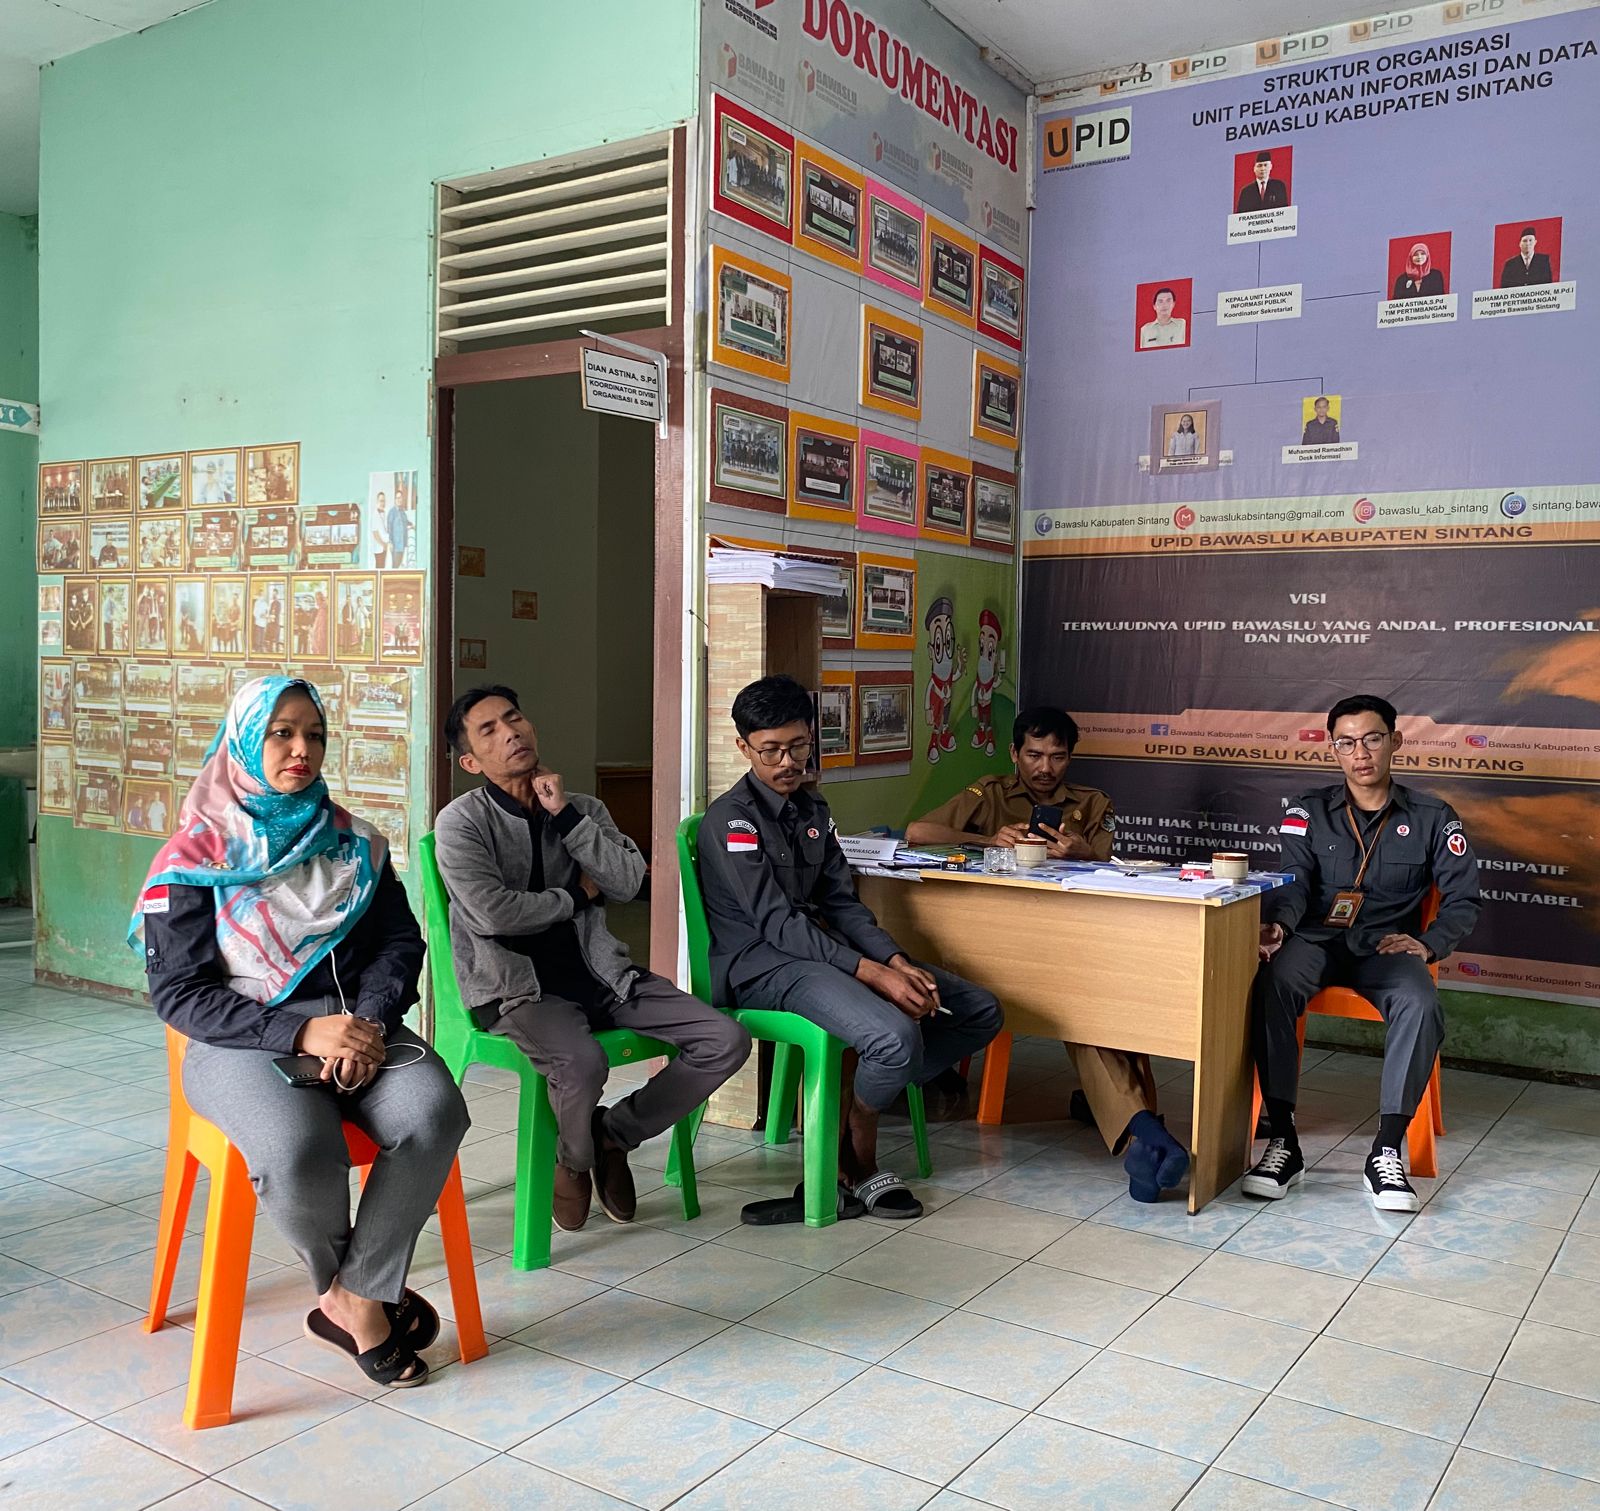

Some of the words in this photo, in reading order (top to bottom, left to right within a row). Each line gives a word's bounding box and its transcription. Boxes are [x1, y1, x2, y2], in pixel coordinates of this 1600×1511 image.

[1352, 14, 1414, 37] UPID
[1259, 34, 1329, 60] UPID
[1173, 55, 1227, 76] UPID
[1263, 60, 1370, 93] STRUKTUR
[1376, 32, 1511, 73] ORGANISASI
[738, 53, 785, 92] BAWASLU
[803, 0, 1018, 172] DOKUMENTASI
[816, 69, 857, 105] BAWASLU
[1192, 106, 1234, 127] UNIT
[1239, 84, 1354, 119] PELAYANAN
[1360, 61, 1477, 98] INFORMASI
[1484, 51, 1531, 75] DAN
[1538, 40, 1598, 65] DATA
[1225, 111, 1318, 142] BAWASLU
[1325, 89, 1449, 125] KABUPATEN
[1456, 71, 1554, 102] SINTANG
[1047, 117, 1130, 158] UPID
[1248, 218, 1274, 227] PEMBINA
[1229, 229, 1247, 238] Ketua
[1248, 227, 1272, 236] Bawaslu
[1273, 223, 1296, 233] Sintang
[1225, 296, 1248, 304] KEPALA
[1264, 290, 1293, 299] LAYANAN
[1230, 301, 1263, 309] INFORMASI
[1264, 298, 1287, 306] PUBLIK
[1474, 294, 1509, 303] MUHAMAD
[1502, 296, 1557, 307] PERTIMBANGAN
[1223, 310, 1259, 318] Koordinator
[1260, 305, 1293, 315] Sekretariat
[1396, 305, 1447, 314] PERTIMBANGAN
[1480, 308, 1506, 317] Anggota
[1508, 305, 1534, 314] Bawaslu
[1535, 302, 1560, 311] Sintang
[1379, 315, 1404, 325] Anggota
[1405, 313, 1430, 322] Bawaslu
[1431, 311, 1455, 320] Sintang
[587, 363, 607, 374] DIAN
[608, 368, 639, 381] ASTINA,
[640, 375, 657, 385] S.Pd
[589, 380, 637, 394] KOORDINATOR
[638, 390, 656, 399] DIVISI
[592, 389, 633, 403] ORGANISASI
[640, 399, 654, 408] SDM
[1288, 448, 1321, 456] Muhammad
[1321, 446, 1353, 454] Ramadhan
[1314, 453, 1341, 461] Informasi
[1379, 503, 1489, 517] bawaslu_kab_sintang
[1532, 499, 1600, 512] sintang.baw
[1055, 520, 1089, 530] Bawaslu
[1090, 517, 1136, 529] Kabupaten
[1137, 515, 1170, 528] Sintang
[1200, 508, 1345, 523] bawaslukabsintang@gmail.com
[1150, 537, 1193, 548] UPID
[1200, 533, 1295, 547] BAWASLU
[1302, 529, 1427, 543] KABUPATEN
[1435, 526, 1533, 540] SINTANG
[1289, 593, 1326, 605] VISI
[1062, 621, 1178, 631] TERWUJUDNYA
[1184, 621, 1226, 631] UPID
[1232, 621, 1316, 631] BAWASLU
[1322, 620, 1371, 631] YANG
[1377, 620, 1447, 633] ANDAL,
[1454, 620, 1599, 632] PROFESIONAL
[1244, 633, 1280, 644] DAN
[1287, 633, 1371, 644] INOVATIF
[1170, 729, 1206, 738] Bawaslu
[1207, 730, 1253, 740] Kabupaten
[1255, 732, 1289, 741] Sintang
[1421, 739, 1457, 749] sintang
[1488, 740, 1531, 750] Bawaslu
[1534, 743, 1590, 752] Kabupaten
[1144, 743, 1187, 756] UPID
[1193, 746, 1288, 760] BAWASLU
[1427, 756, 1524, 772] SINTANG
[1158, 818, 1192, 829] HAK
[1198, 820, 1262, 835] PUBLIK
[1127, 843, 1187, 857] PEMILU
[1174, 835, 1282, 853] TERWUJUDNY
[1476, 859, 1570, 876] TISIPATIF
[1479, 888, 1584, 908] KUNTABEL
[1480, 969, 1523, 982] Bawaslu
[1525, 975, 1581, 988] Kabupaten
